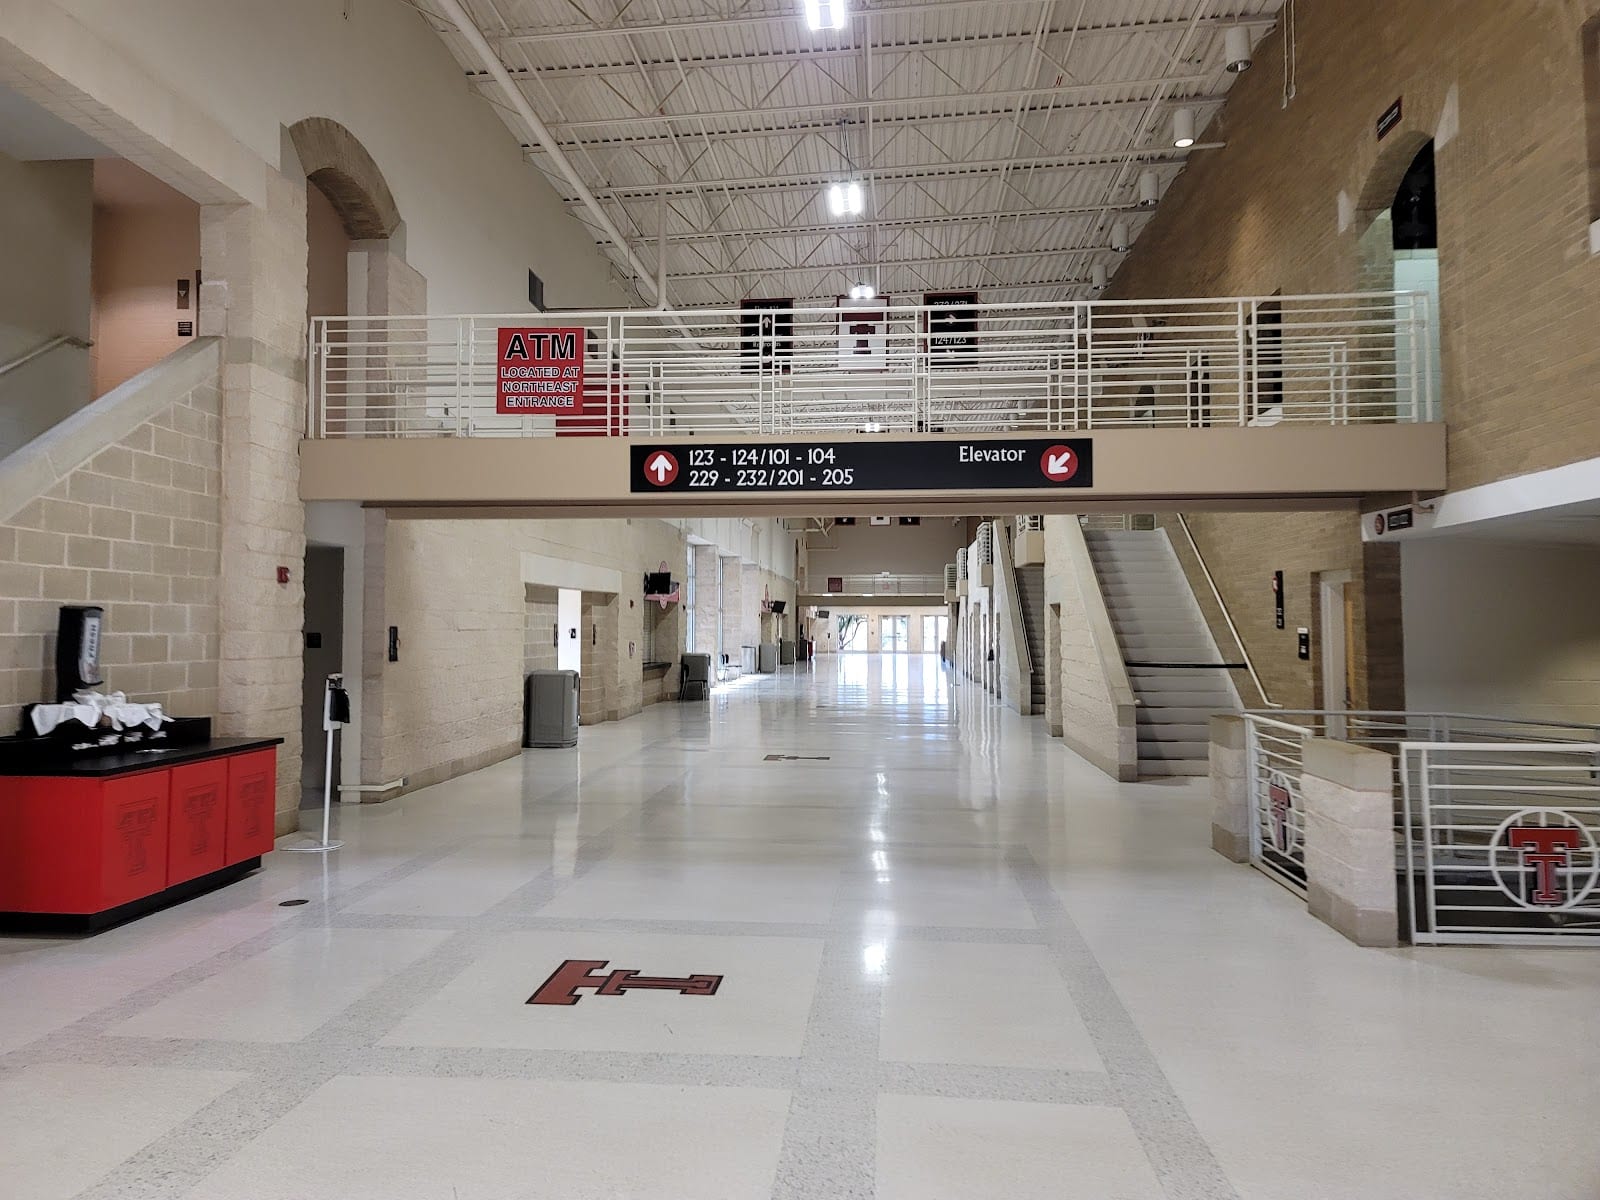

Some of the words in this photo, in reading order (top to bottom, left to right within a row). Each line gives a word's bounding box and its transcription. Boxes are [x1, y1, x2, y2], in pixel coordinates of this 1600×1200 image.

[505, 333, 576, 360] ATM
[501, 367, 560, 379] LOCATED
[562, 366, 580, 378] AT
[502, 381, 579, 393] NORTHEAST
[506, 396, 574, 408] ENTRANCE
[689, 450, 714, 466] 123
[732, 449, 790, 466] 124/101
[808, 448, 836, 465] 104
[960, 446, 1026, 462] Elevator
[689, 470, 719, 487] 229
[736, 469, 804, 486] 232/201
[822, 468, 854, 486] 205
